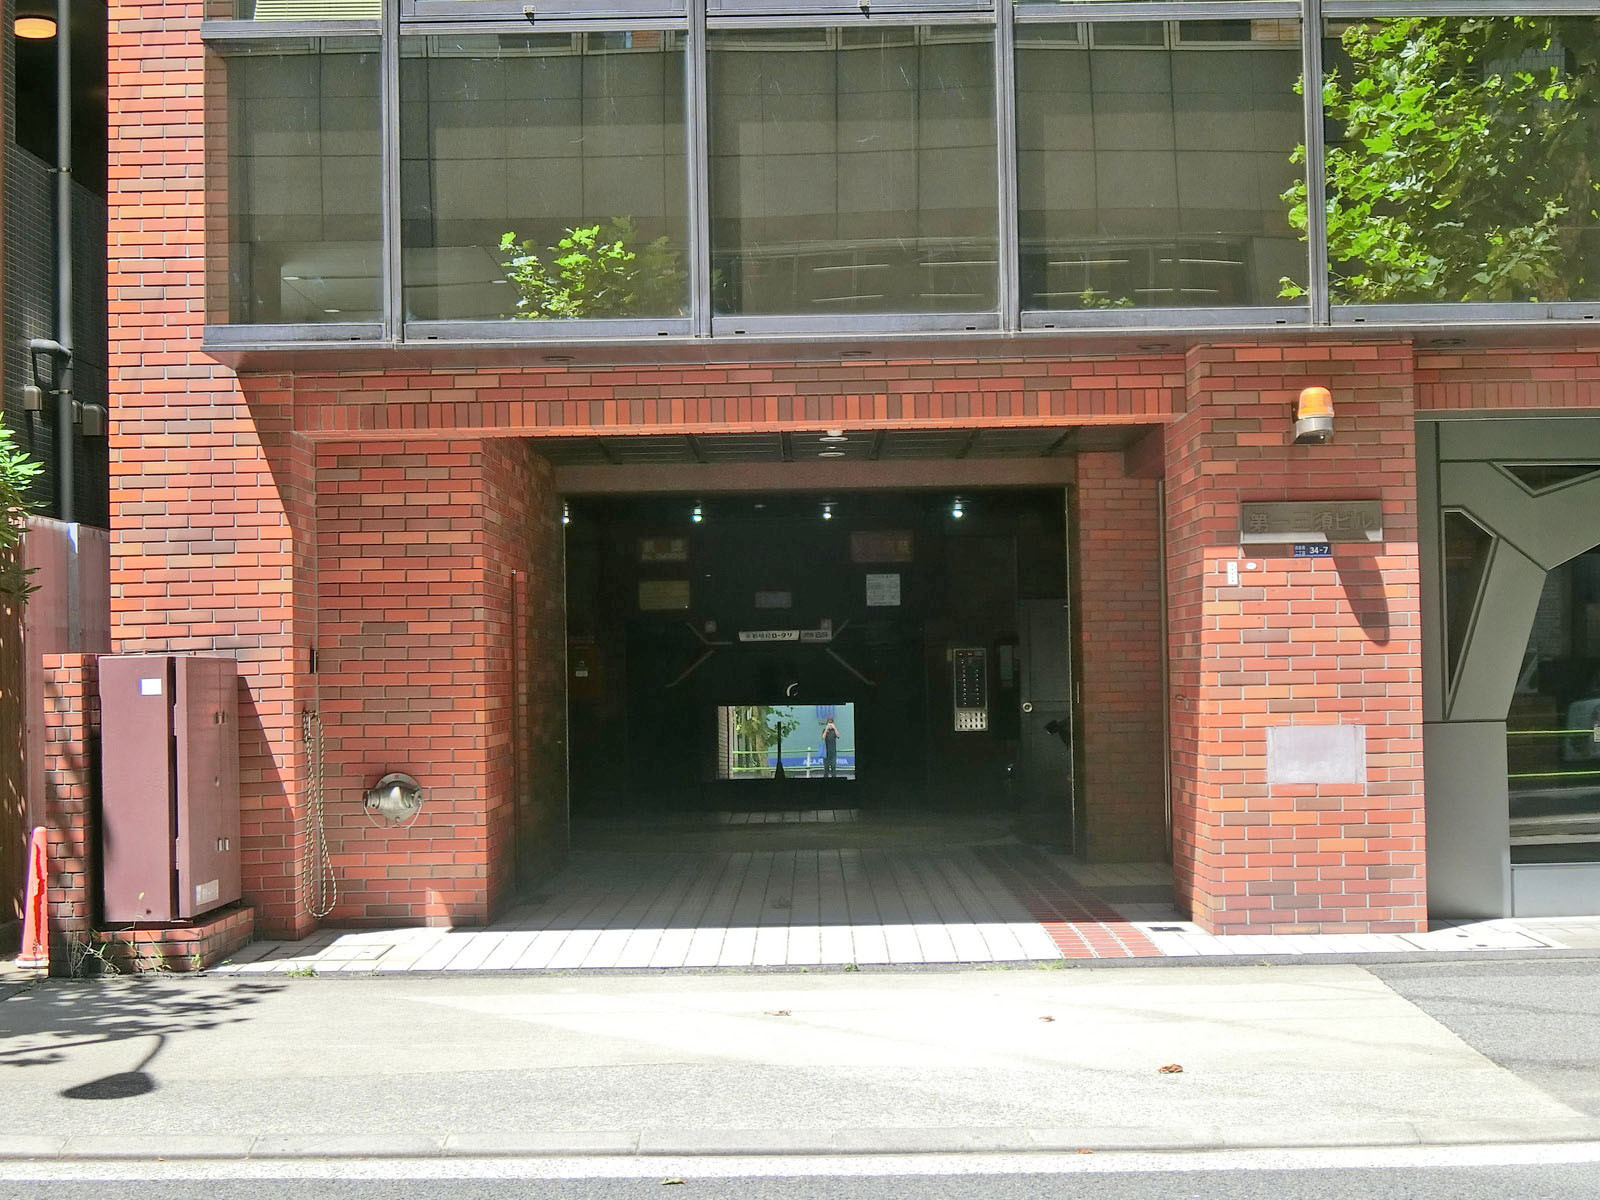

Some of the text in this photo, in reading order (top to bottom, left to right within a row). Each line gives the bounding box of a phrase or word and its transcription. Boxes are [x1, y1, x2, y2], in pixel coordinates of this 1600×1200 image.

[1249, 511, 1376, 533] 第一三須ビル
[1309, 546, 1329, 554] 34-7
